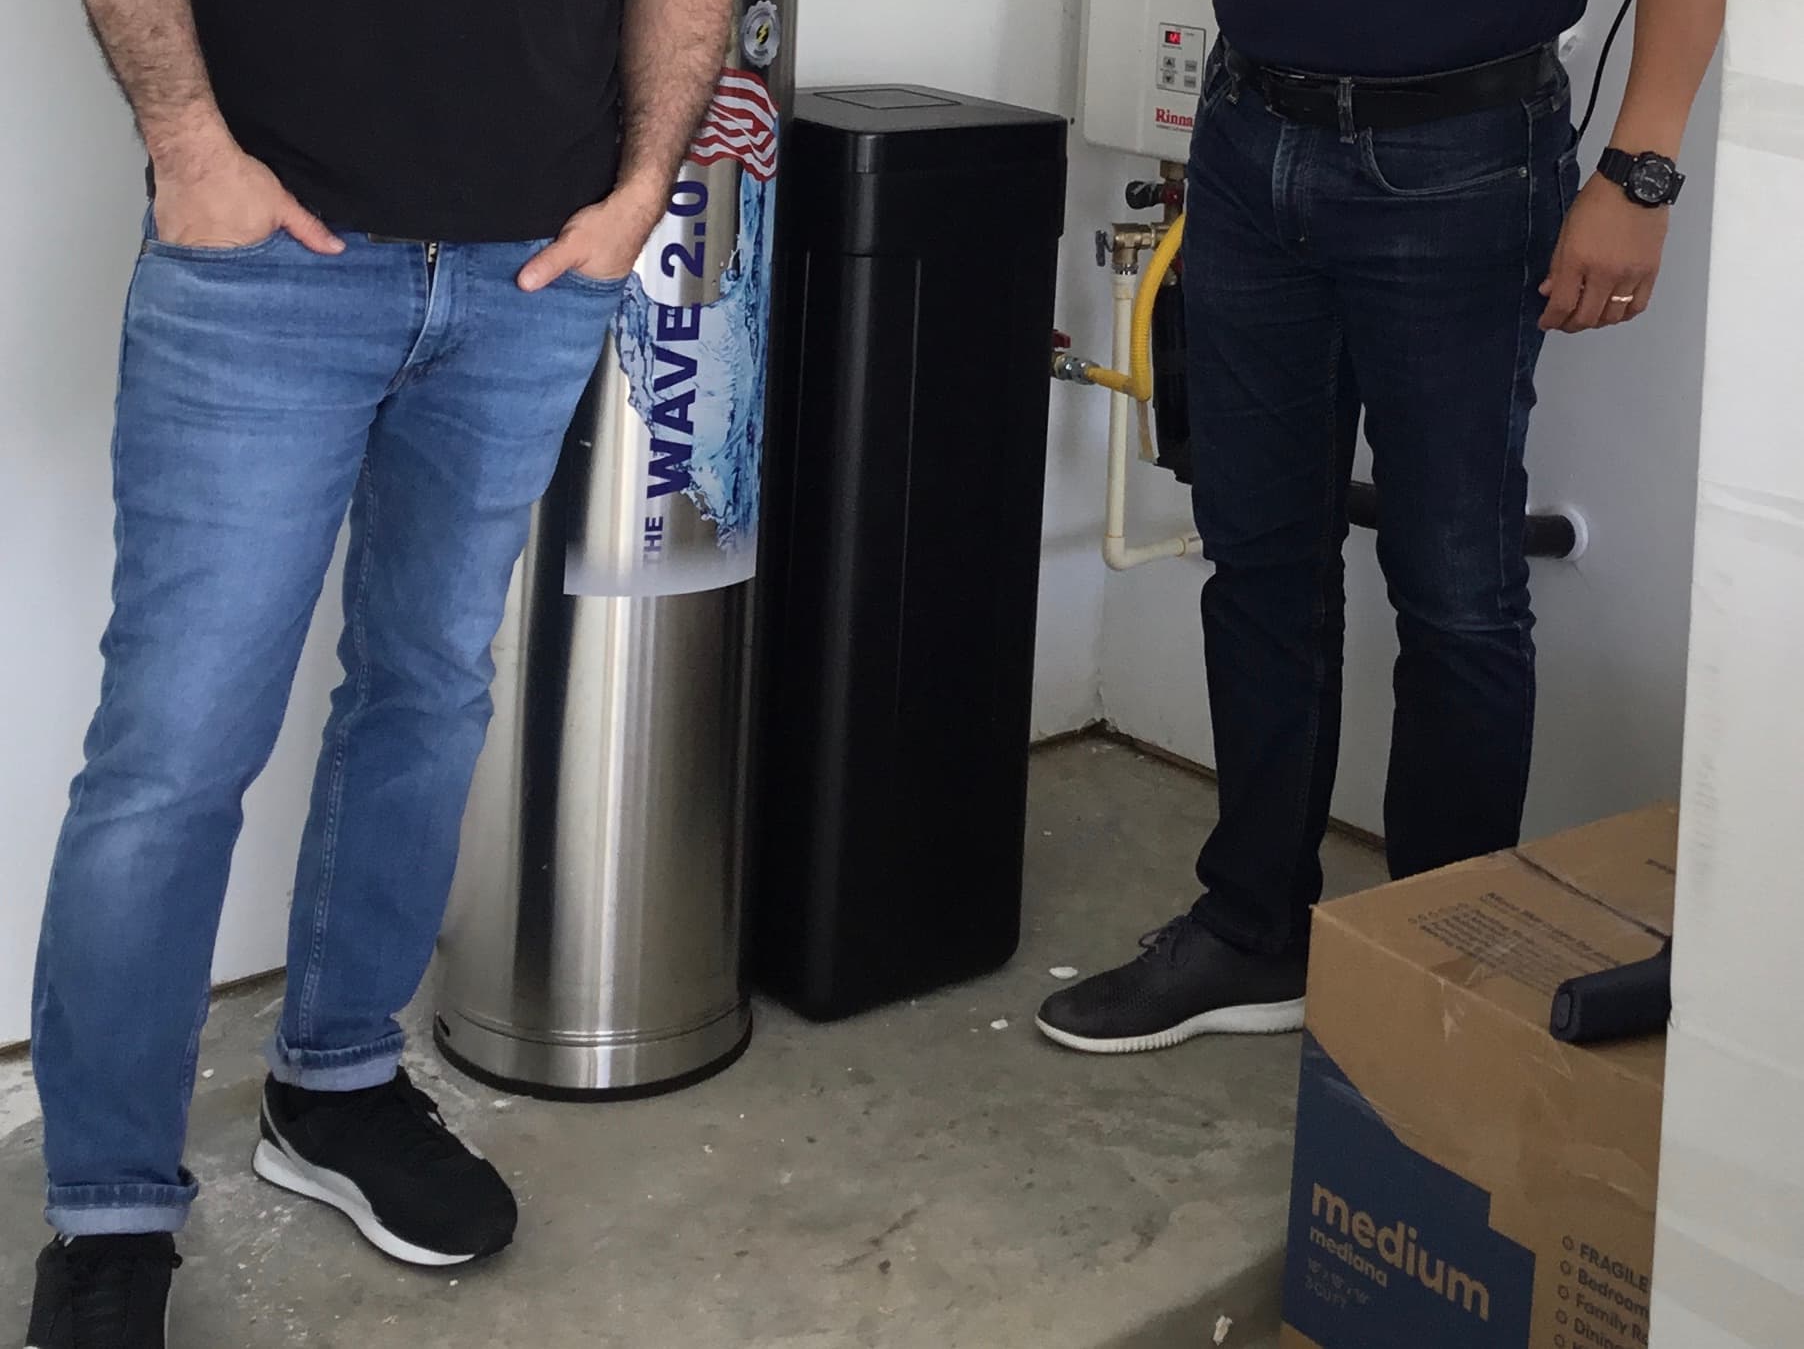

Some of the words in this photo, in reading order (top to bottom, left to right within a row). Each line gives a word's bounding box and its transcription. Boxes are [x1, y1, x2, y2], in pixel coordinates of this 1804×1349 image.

[1155, 107, 1193, 127] Rinna
[661, 181, 709, 279] 2.0
[647, 303, 701, 499] WAVE
[643, 516, 664, 565] THE
[1309, 1226, 1388, 1289] mediana
[1311, 1182, 1490, 1322] medium
[1580, 1242, 1649, 1294] FRAGILE
[1574, 1317, 1626, 1349] Dinin
[1576, 1292, 1627, 1334] Family
[1632, 1322, 1649, 1347] Ro
